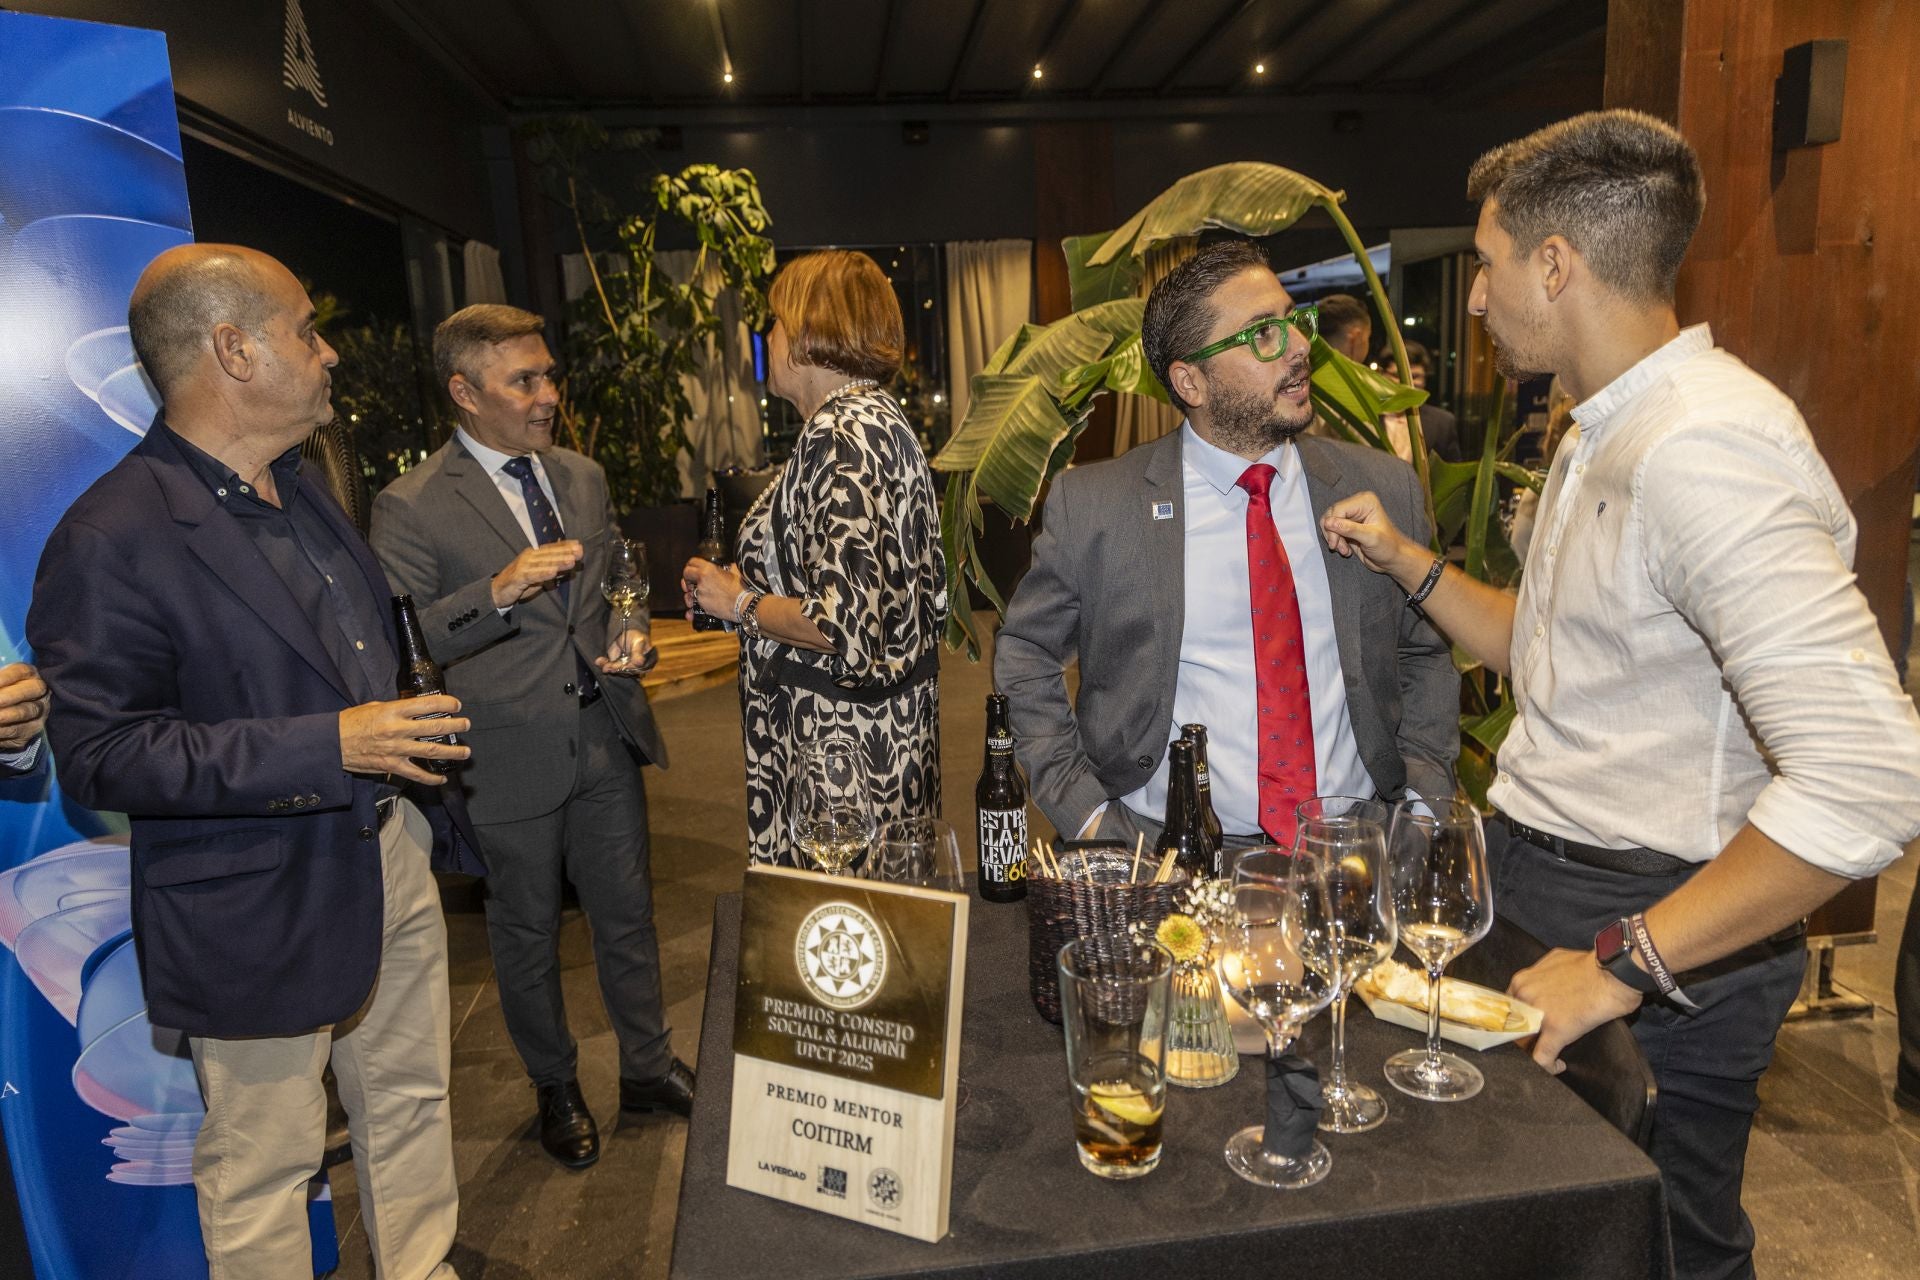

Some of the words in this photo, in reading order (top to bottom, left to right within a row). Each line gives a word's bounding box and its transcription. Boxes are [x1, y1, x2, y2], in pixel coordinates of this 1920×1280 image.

[1008, 860, 1028, 881] 60
[762, 996, 836, 1025] PREMIOS
[839, 1012, 915, 1042] CONSEJO
[768, 1015, 823, 1041] SOCIAL
[825, 1028, 837, 1045] &
[840, 1031, 907, 1060] ALUMNI
[795, 1040, 837, 1063] UPCT
[837, 1049, 874, 1071] 2025
[766, 1082, 828, 1110] PREMIO
[833, 1098, 904, 1129] MENTOR
[791, 1117, 874, 1155] COITIRM
[757, 1160, 770, 1172] LA
[770, 1163, 807, 1181] VERDAD
